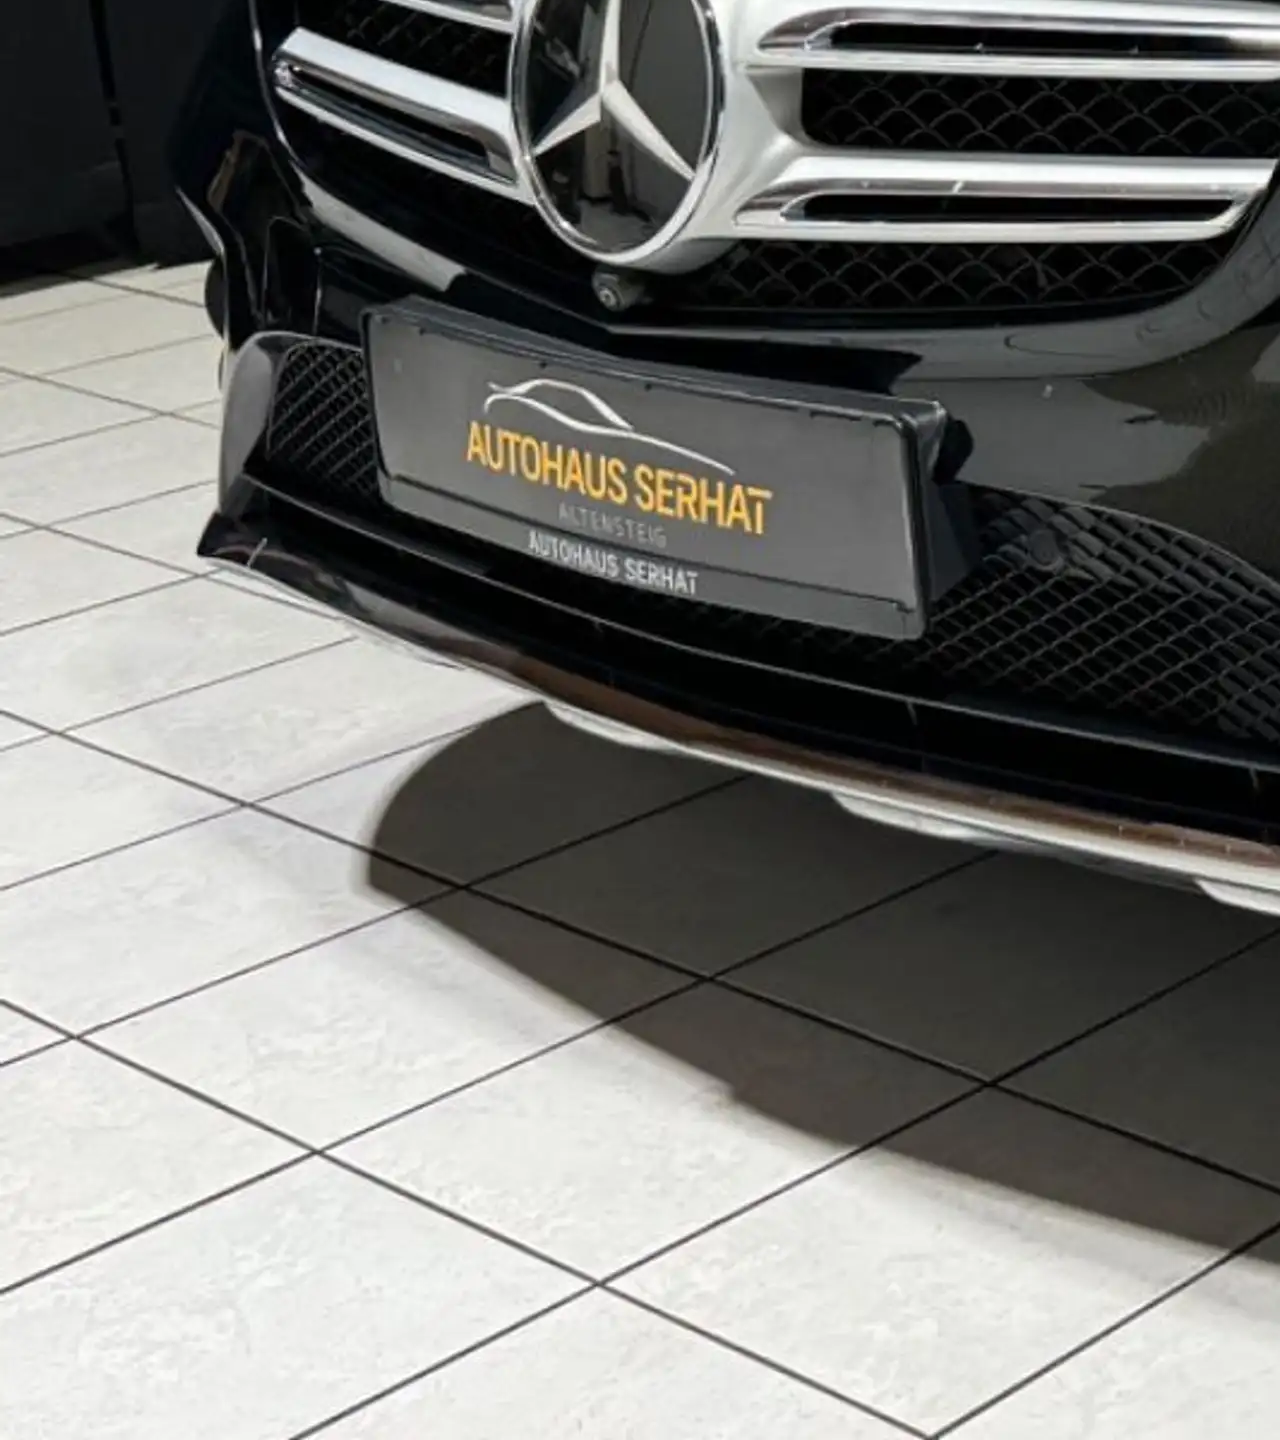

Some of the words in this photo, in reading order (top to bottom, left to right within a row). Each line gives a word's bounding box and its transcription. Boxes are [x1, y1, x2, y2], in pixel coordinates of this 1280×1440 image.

[467, 420, 629, 505] AUTOHAUS
[634, 465, 773, 536] SERHAT
[558, 502, 667, 549] ALTENSTEIG
[528, 529, 619, 580] AUTOHAUS
[624, 548, 698, 596] SERHAT
